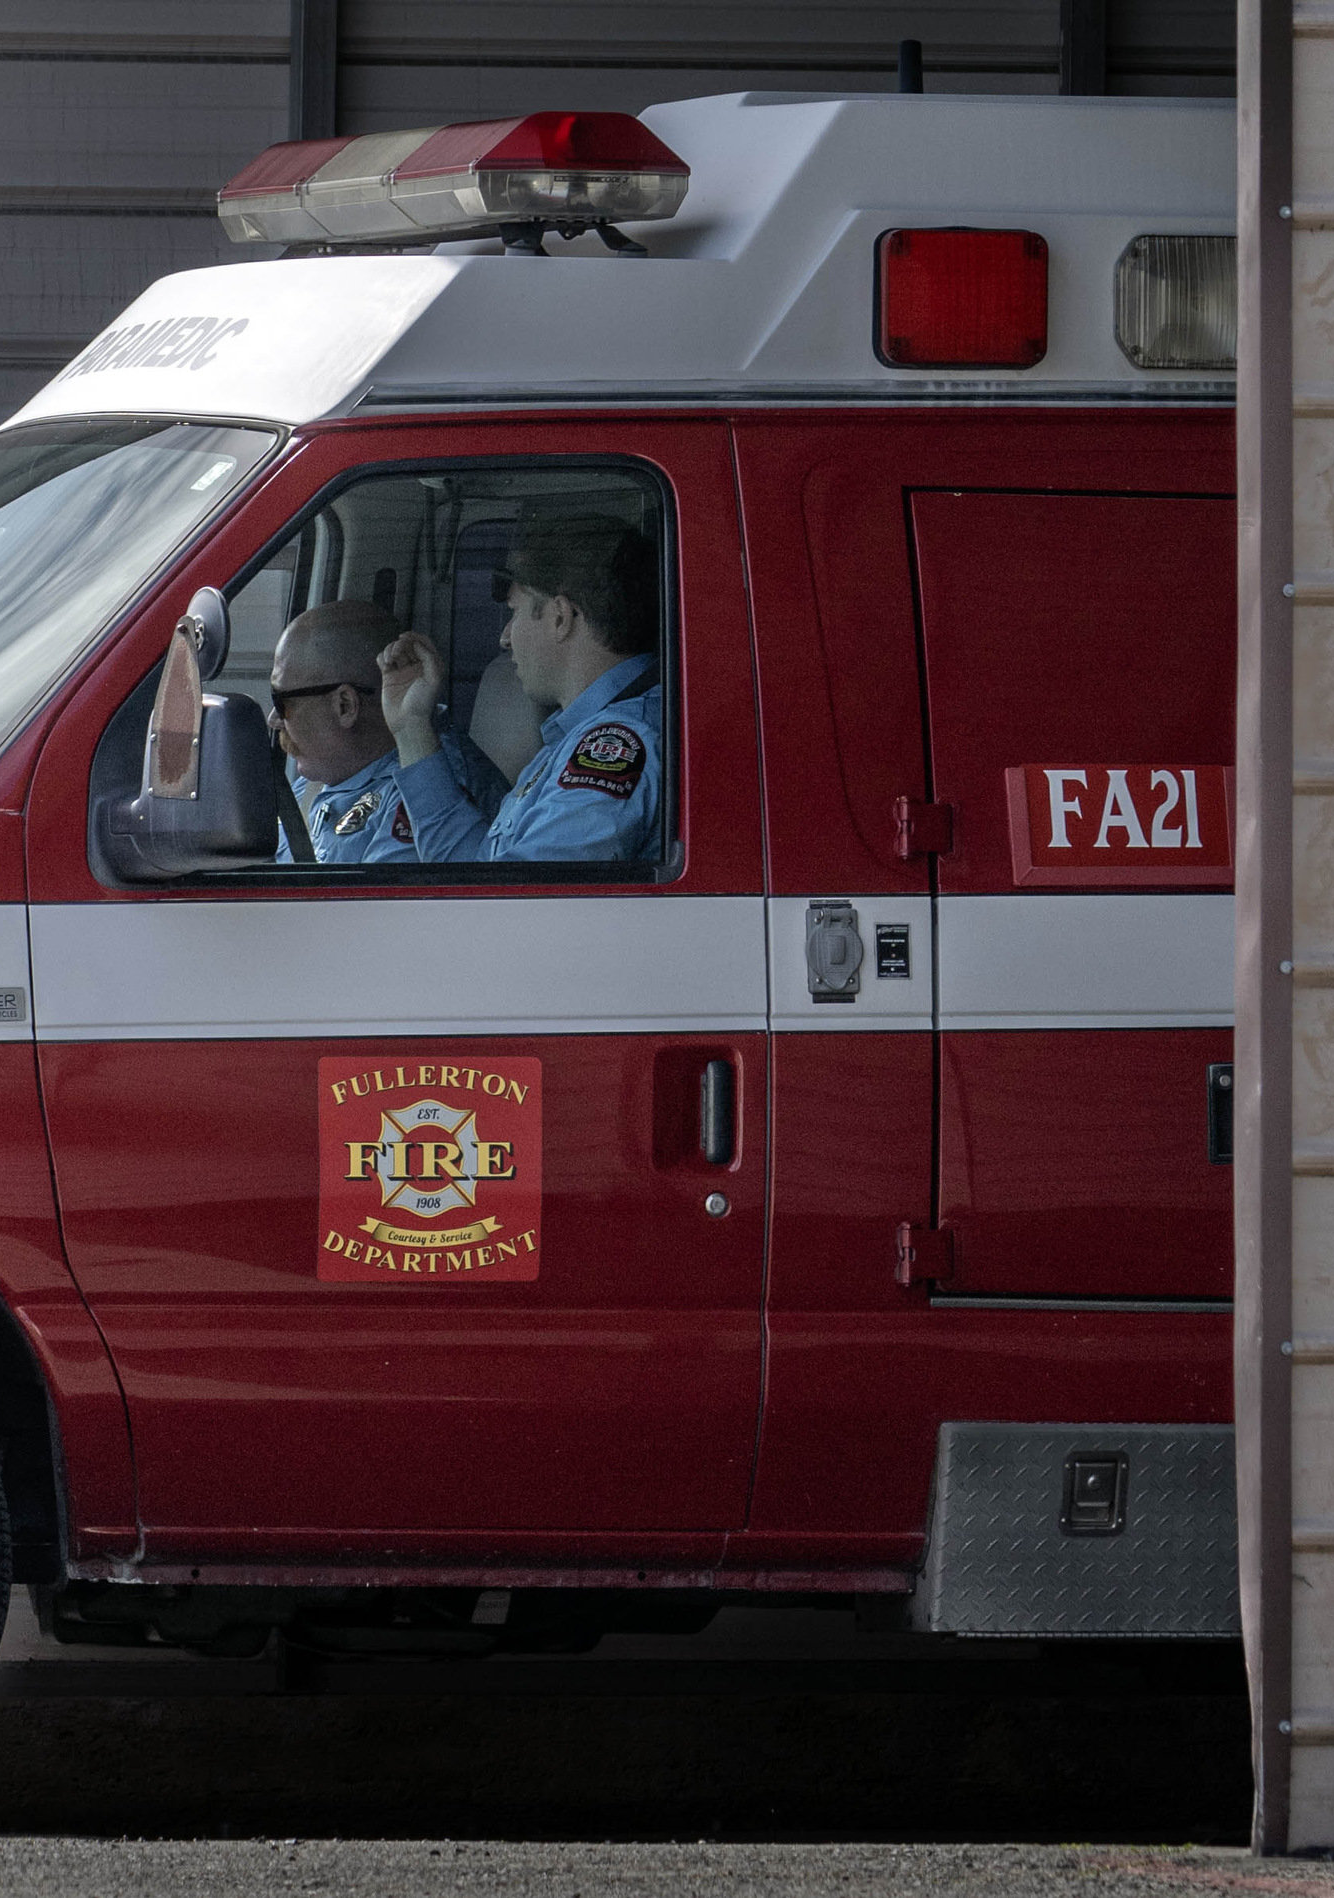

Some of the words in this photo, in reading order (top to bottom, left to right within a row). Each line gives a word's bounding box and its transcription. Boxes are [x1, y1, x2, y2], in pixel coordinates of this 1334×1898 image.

[58, 317, 249, 383] PARAMEDIC
[576, 743, 637, 763] FIRE
[1043, 769, 1203, 848] FA21
[330, 1065, 530, 1105] FULLERTON
[417, 1109, 440, 1120] EST.
[344, 1141, 516, 1181] FIRE
[416, 1198, 441, 1209] 1908
[322, 1229, 538, 1273] DEPARTMENT
[388, 1230, 427, 1245] Courtesy
[430, 1235, 437, 1244] &
[440, 1232, 473, 1244] Service
